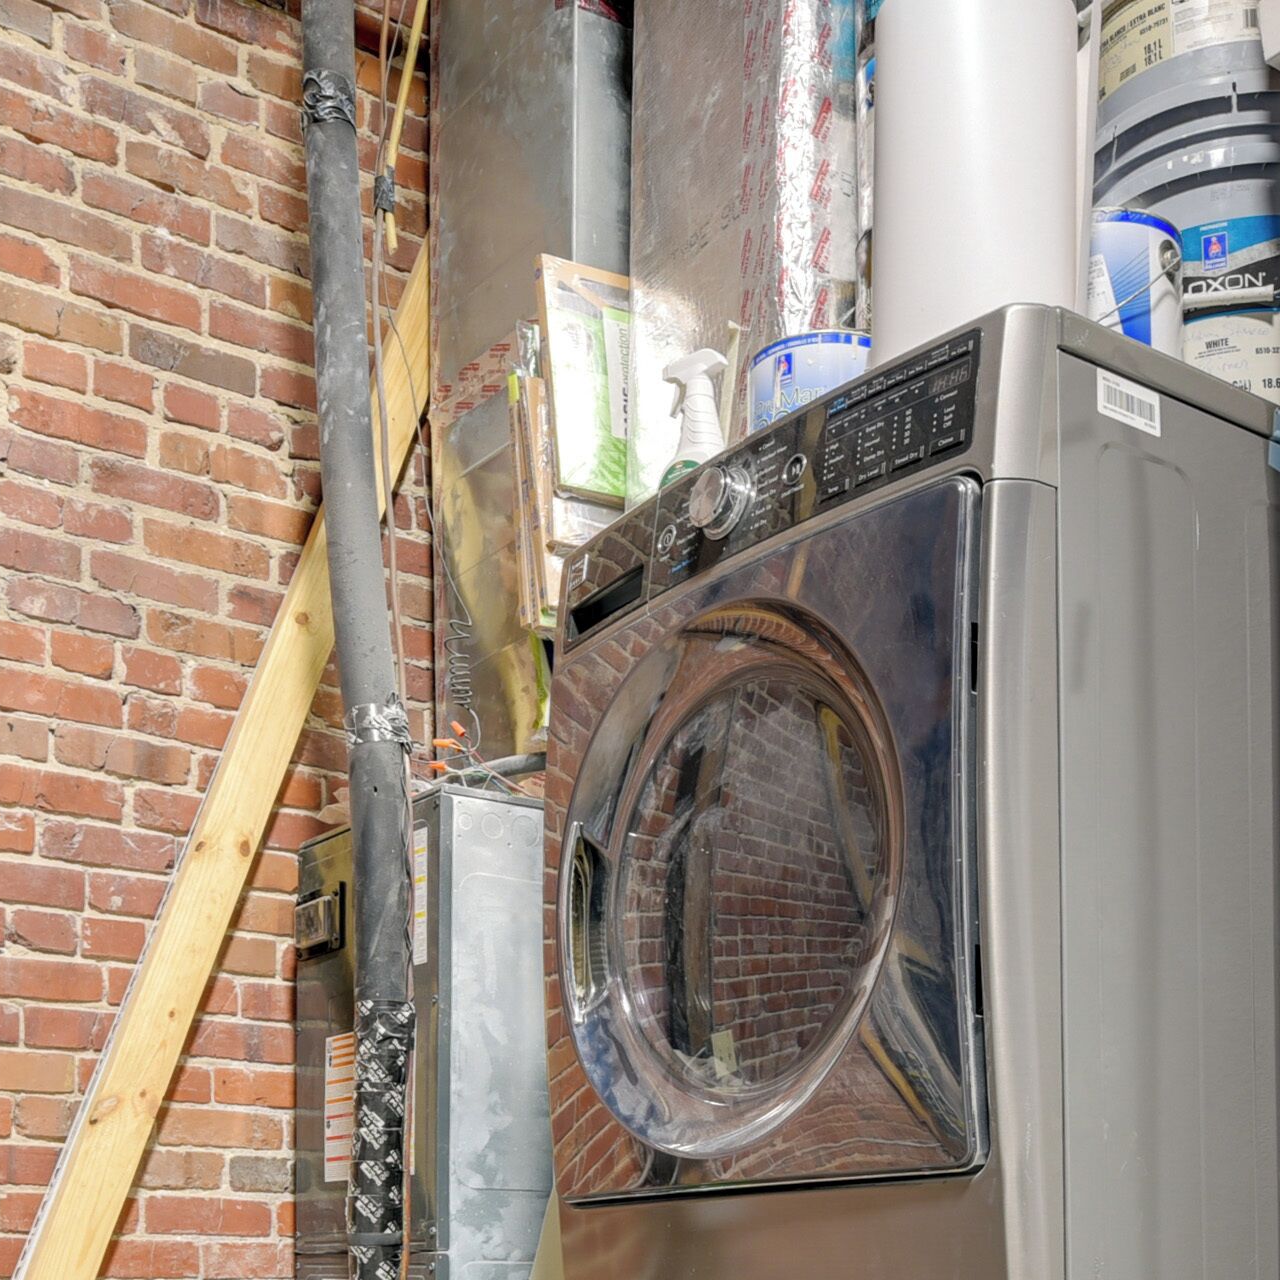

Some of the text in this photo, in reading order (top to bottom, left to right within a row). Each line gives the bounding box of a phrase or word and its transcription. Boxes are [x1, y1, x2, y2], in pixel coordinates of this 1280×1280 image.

[1130, 12, 1146, 27] EXTRA
[1148, 2, 1165, 16] BLANC
[1144, 40, 1157, 55] 18.1
[1144, 52, 1157, 67] 18.1
[1205, 337, 1229, 350] WHITE
